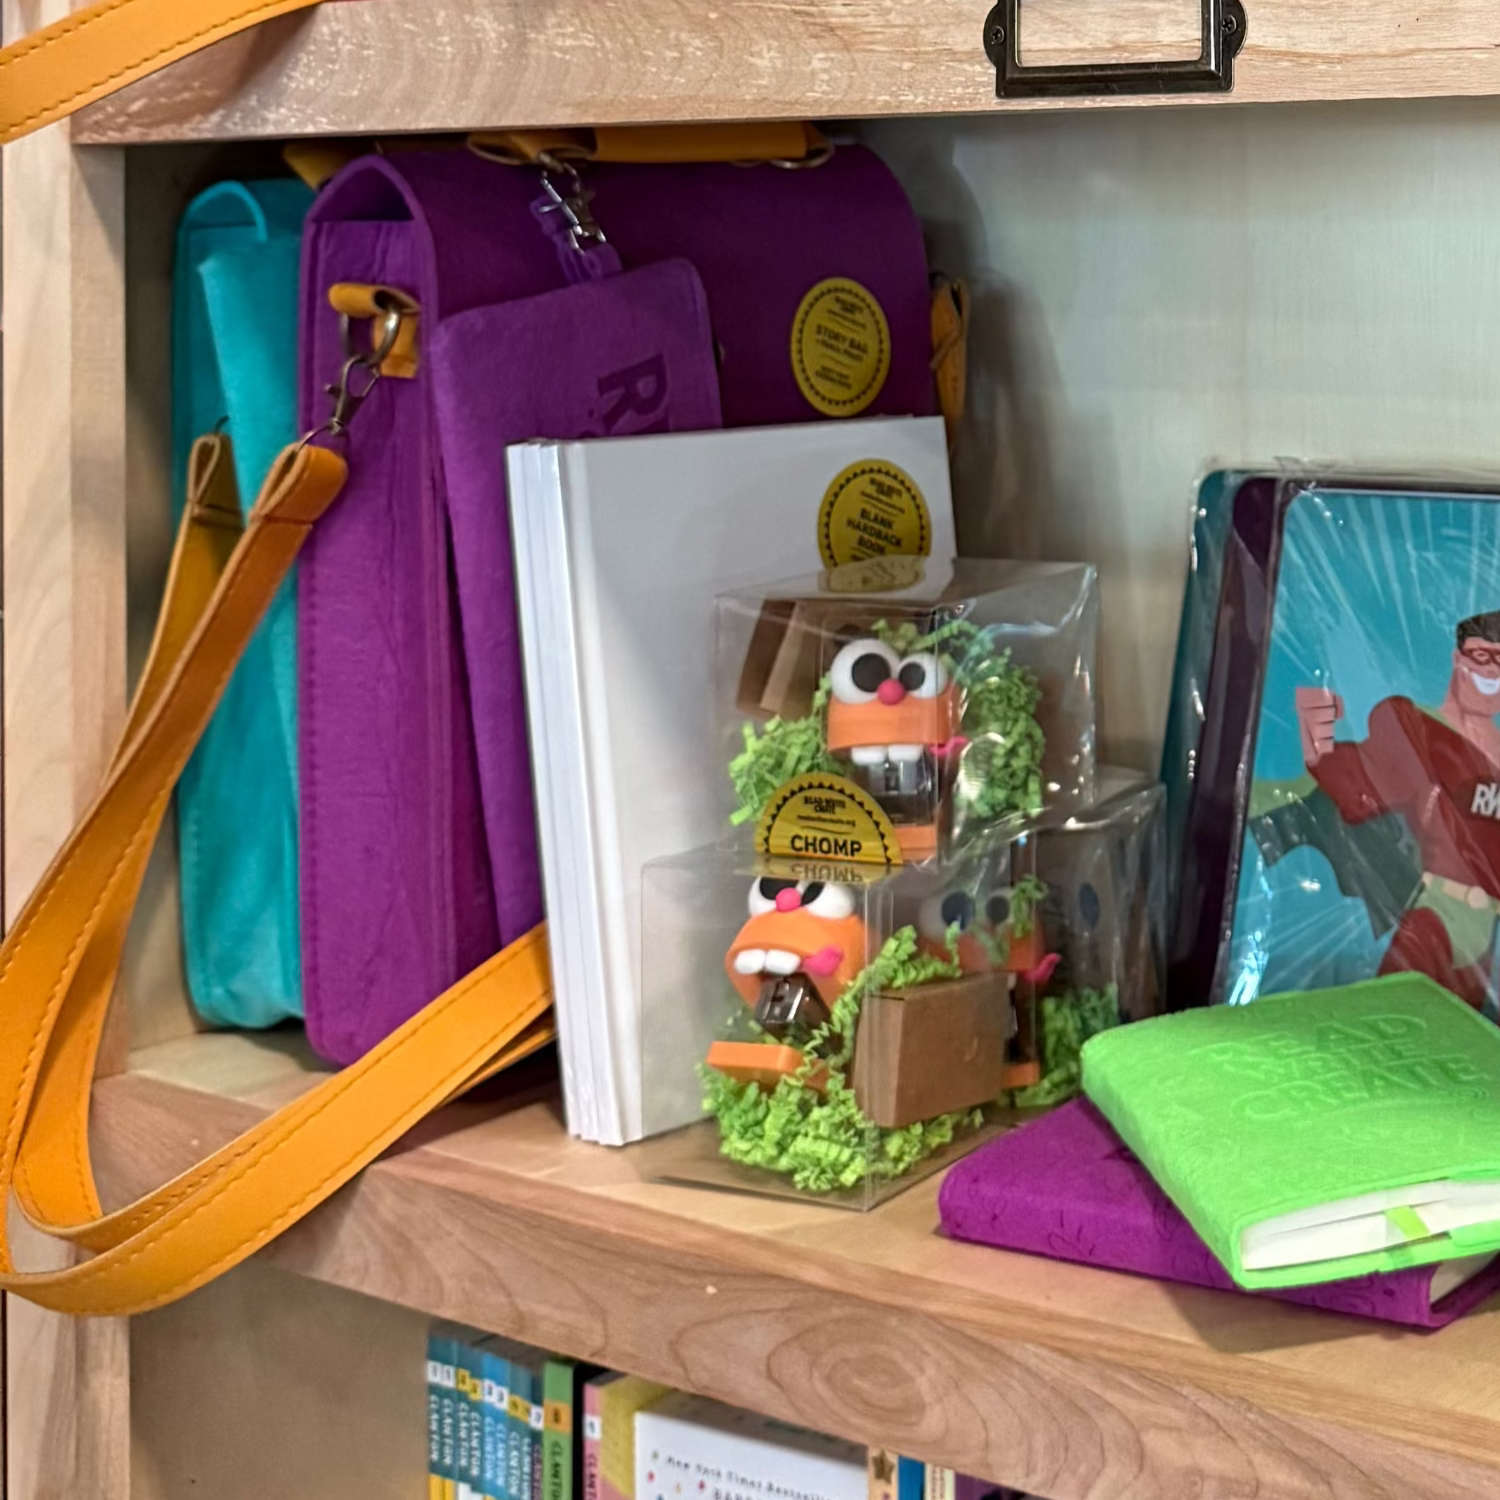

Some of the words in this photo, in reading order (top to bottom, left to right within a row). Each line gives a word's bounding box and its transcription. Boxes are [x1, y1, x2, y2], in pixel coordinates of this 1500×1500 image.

[860, 507, 896, 531] BLANK
[858, 534, 887, 557] BOOK
[790, 833, 863, 858] CHOMP
[551, 1440, 564, 1500] CLANTO
